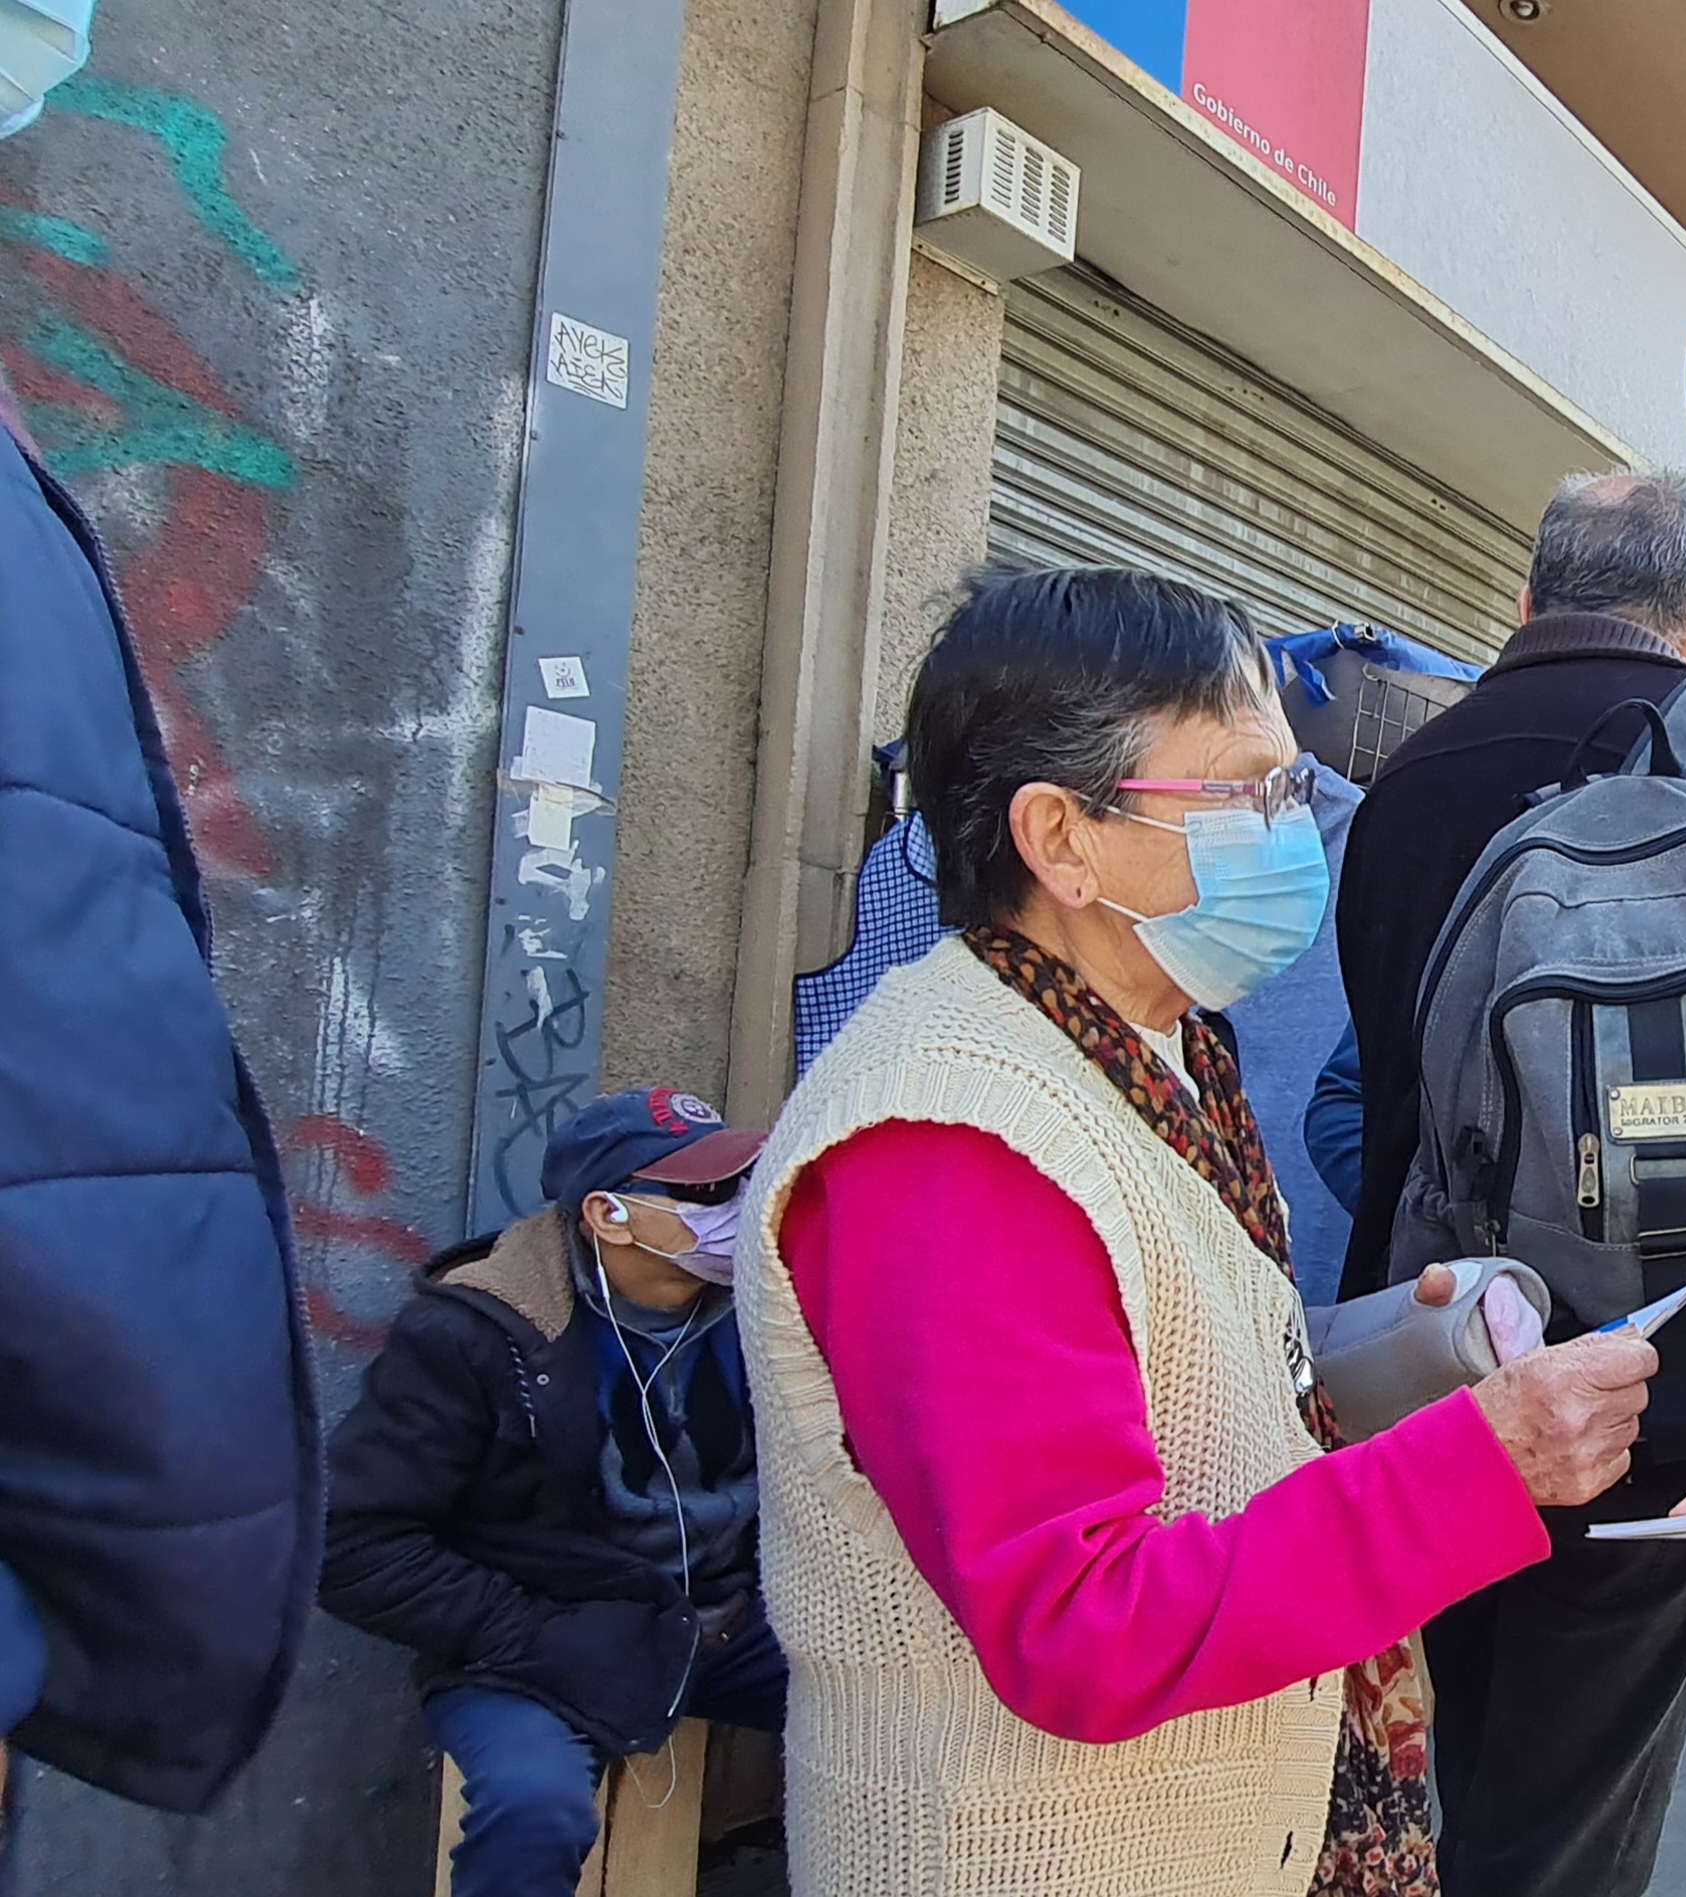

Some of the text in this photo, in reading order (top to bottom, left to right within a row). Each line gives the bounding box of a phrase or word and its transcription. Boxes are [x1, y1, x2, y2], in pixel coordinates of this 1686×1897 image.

[1193, 83, 1337, 206] Gobierno de Chile
